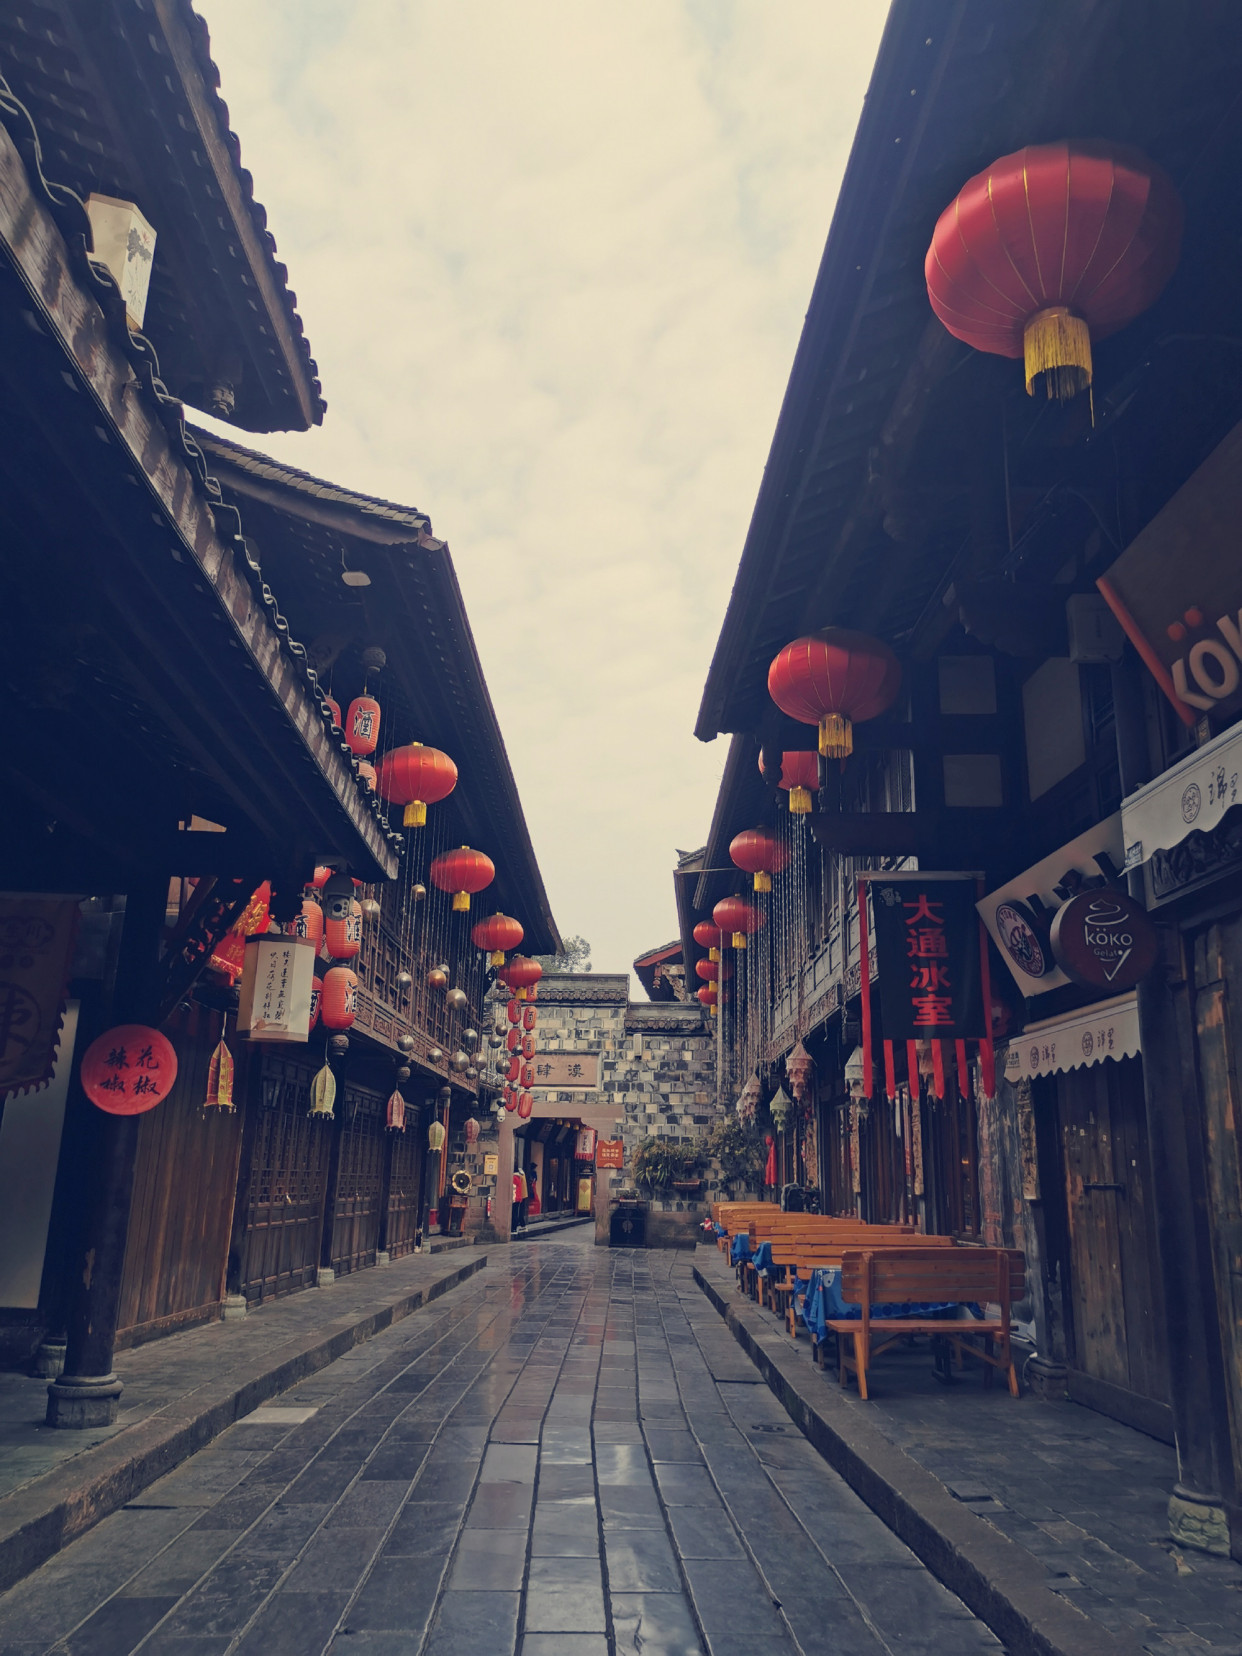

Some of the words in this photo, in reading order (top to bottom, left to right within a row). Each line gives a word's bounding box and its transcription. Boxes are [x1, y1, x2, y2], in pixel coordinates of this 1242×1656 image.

[353, 705, 375, 740] 酒
[903, 893, 955, 1026] 大通冰室
[100, 1045, 130, 1094] 辣椒
[133, 1045, 161, 1096] 花椒
